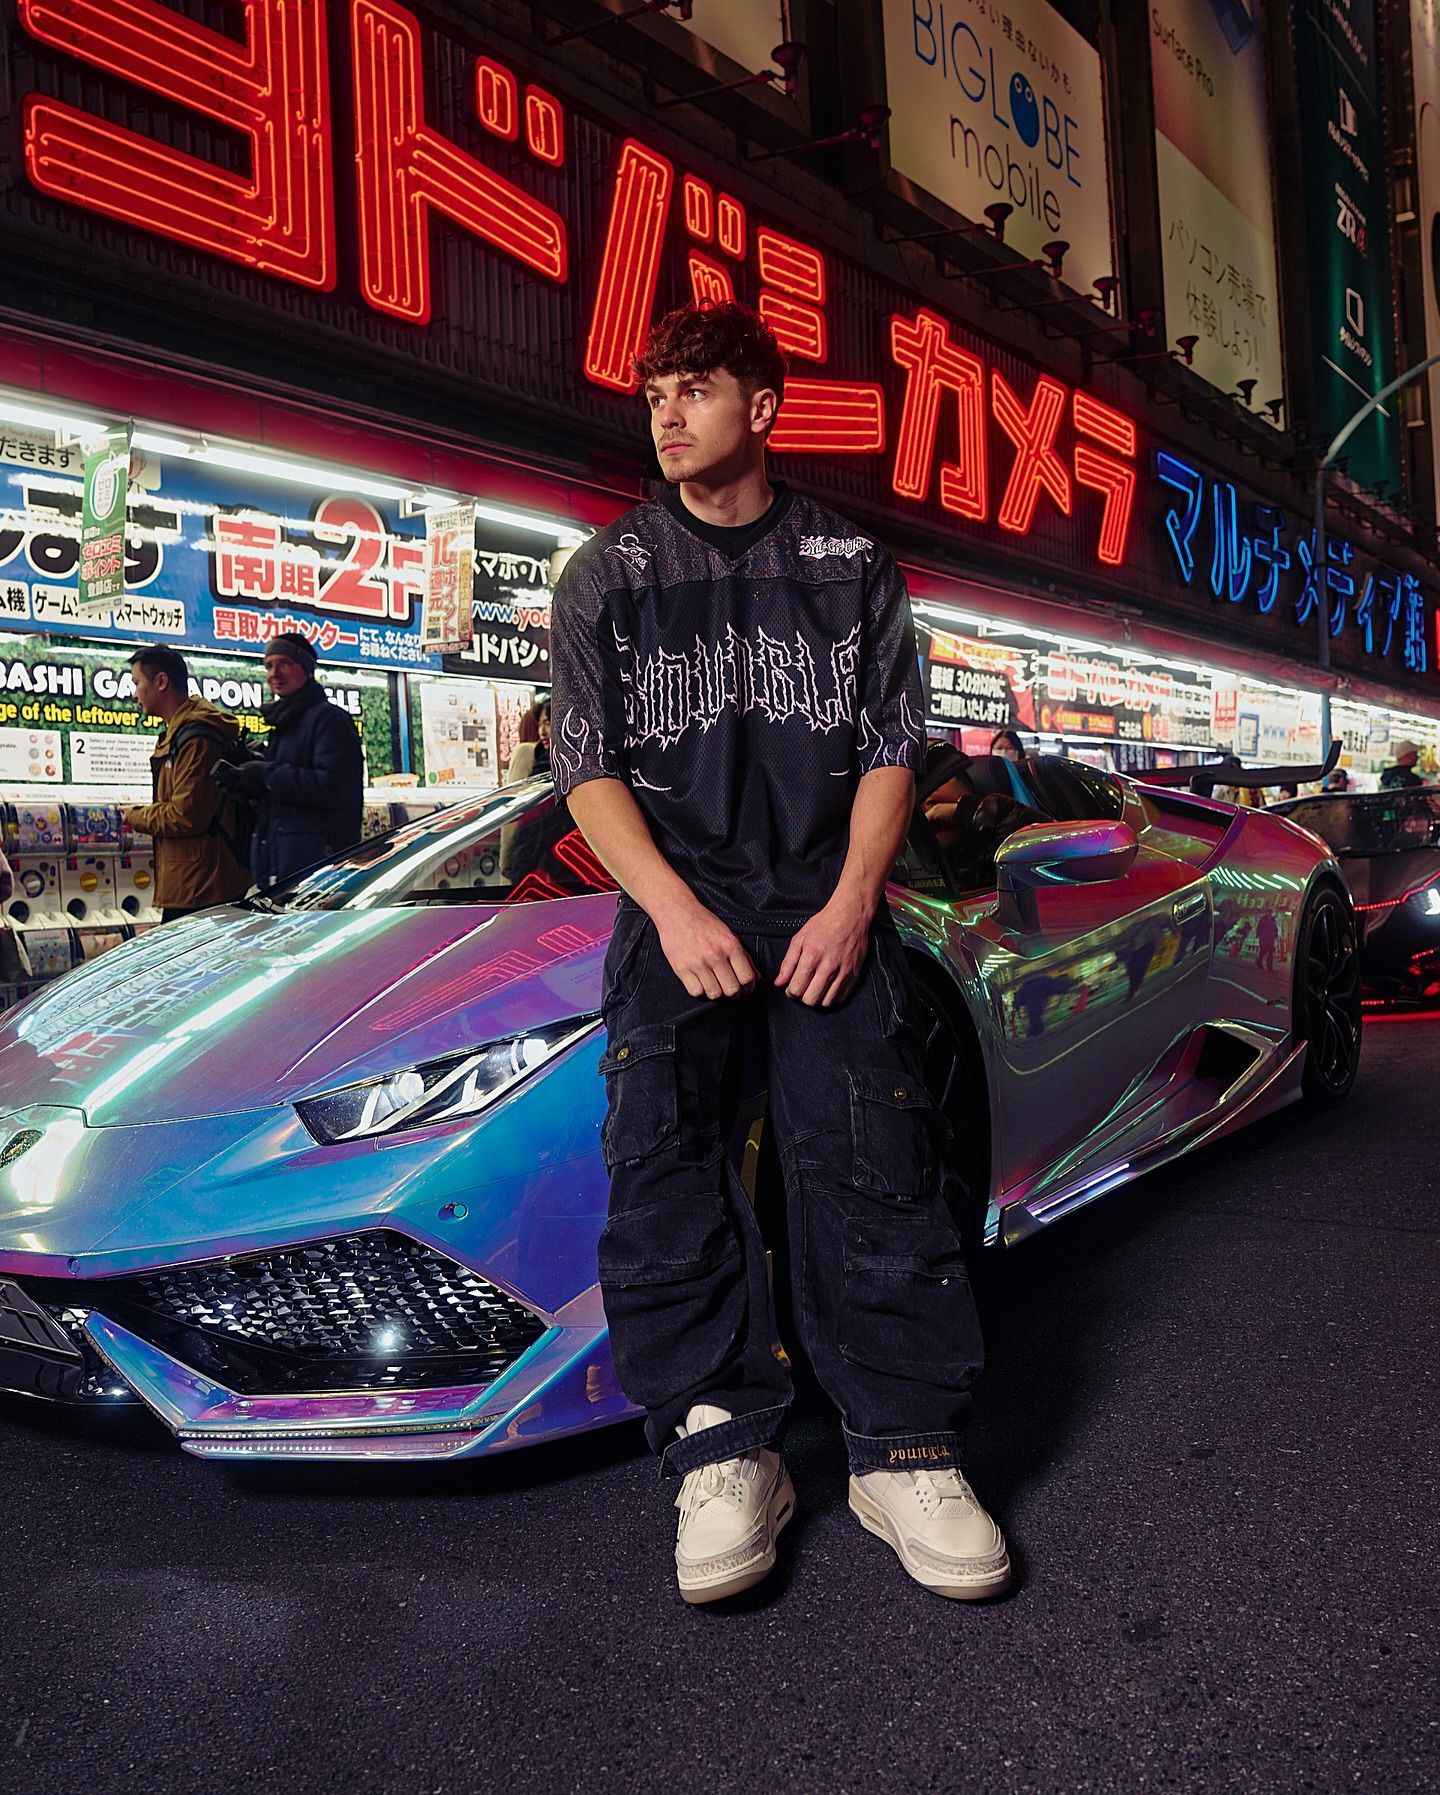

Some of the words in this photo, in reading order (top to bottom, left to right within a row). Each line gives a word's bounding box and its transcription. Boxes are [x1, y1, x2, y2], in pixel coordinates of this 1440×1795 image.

[950, 113, 1061, 232] mobile
[81, 556, 122, 582] ポイント
[22, 702, 40, 721] of
[43, 703, 72, 723] the
[76, 705, 140, 727] leftover
[75, 738, 86, 755] 2
